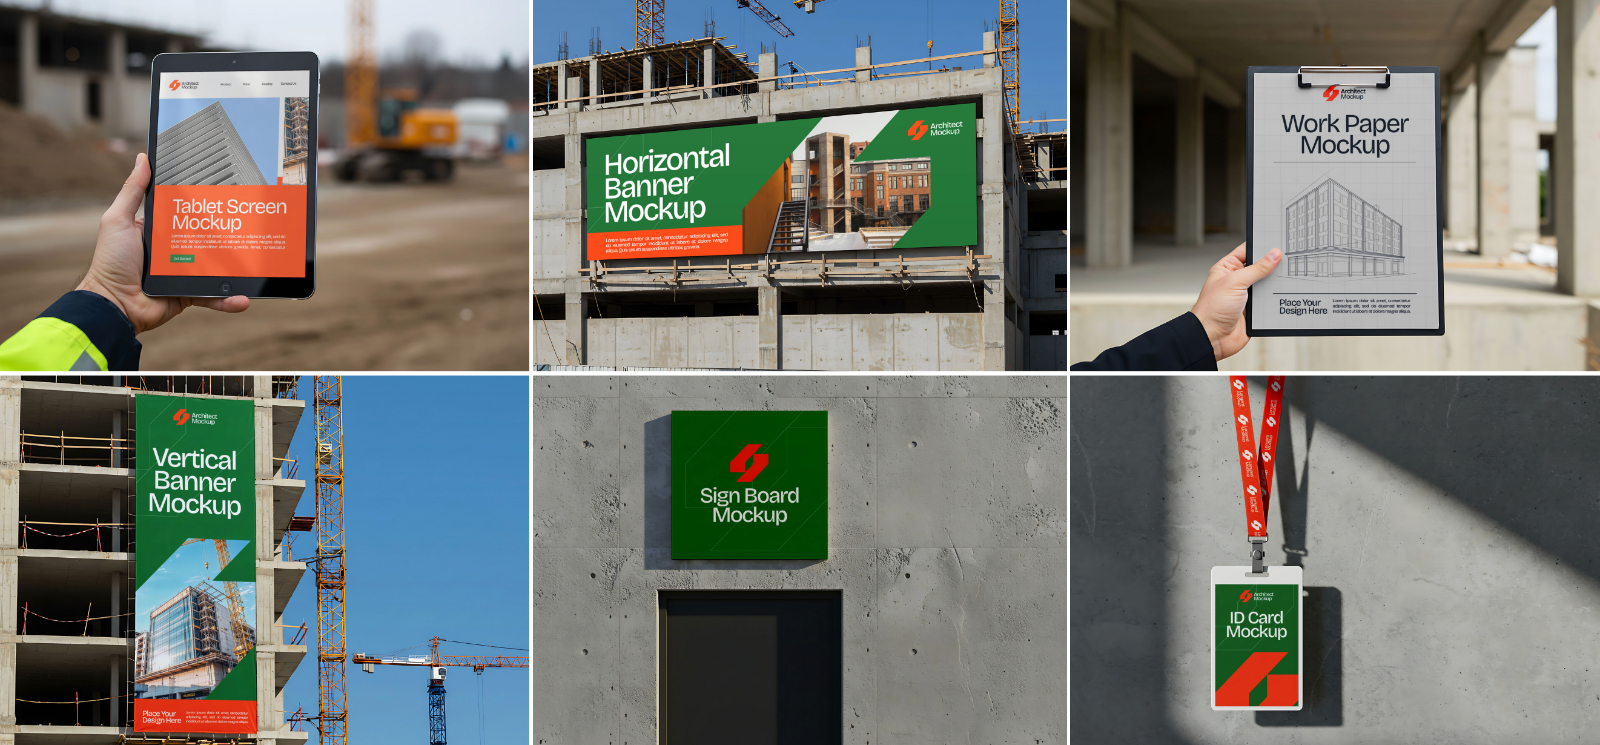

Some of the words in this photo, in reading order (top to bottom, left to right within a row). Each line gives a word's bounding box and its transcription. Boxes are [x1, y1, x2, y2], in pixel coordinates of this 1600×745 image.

[1282, 114, 1340, 133] Work
[1346, 115, 1409, 136] Paper
[1301, 135, 1390, 158] Mockup
[606, 143, 729, 175] Horizontal
[606, 176, 694, 199] Banner
[173, 198, 223, 214] Tablet
[227, 199, 287, 214] Screen
[606, 197, 706, 223] Mockup
[173, 214, 242, 233] Mockup
[1280, 307, 1307, 316] Design
[152, 448, 236, 470] Vertical
[155, 470, 236, 492] Banner
[149, 493, 241, 519] Mockup
[700, 487, 740, 507] Sign
[745, 487, 799, 504] Board
[713, 506, 787, 526] Mockup
[1230, 612, 1245, 624] ID
[1248, 611, 1283, 624] Card
[1226, 625, 1288, 640] Mockup
